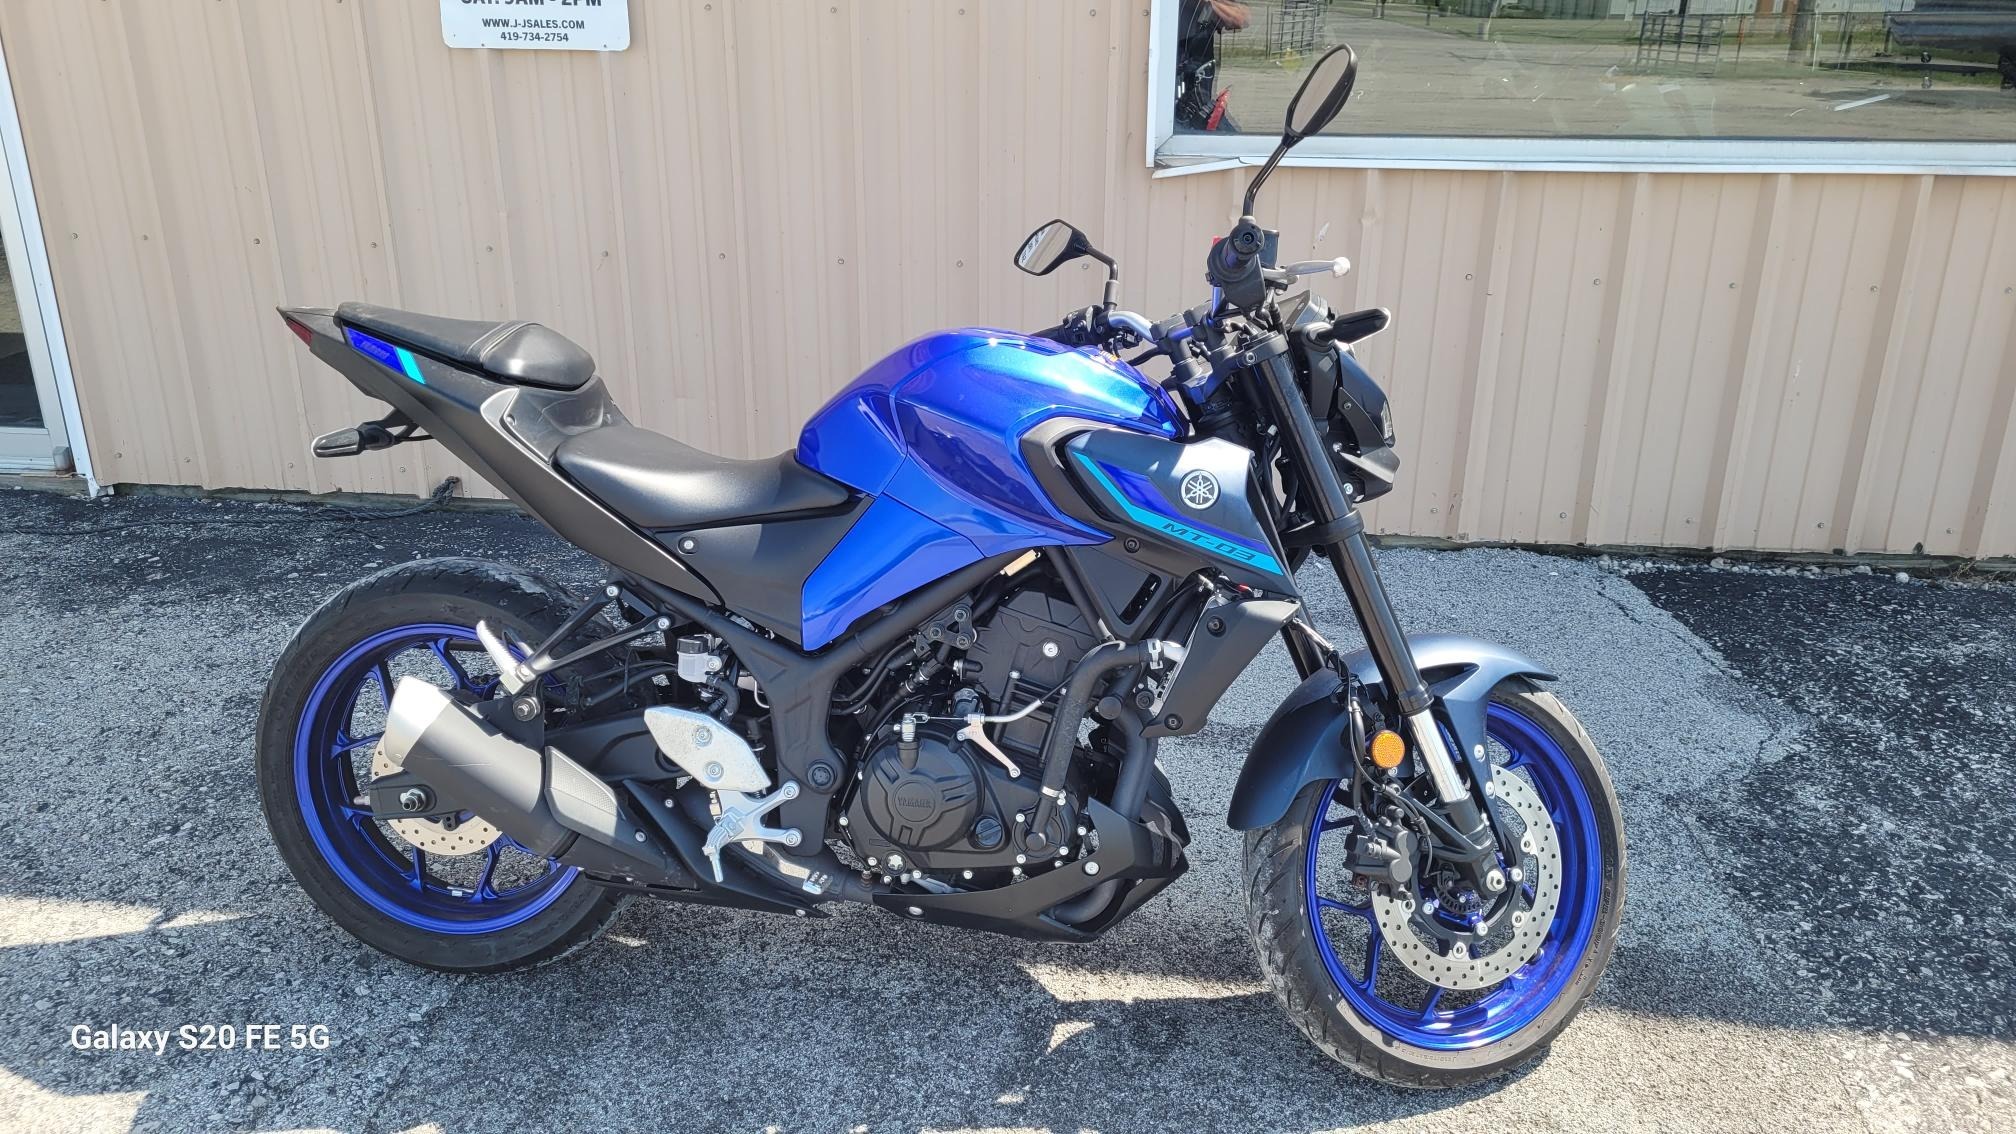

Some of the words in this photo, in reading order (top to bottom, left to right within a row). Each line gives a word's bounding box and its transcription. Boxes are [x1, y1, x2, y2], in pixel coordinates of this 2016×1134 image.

[482, 18, 585, 29] WWW.J-JSALES.COM
[500, 32, 569, 42] 419-734-2754
[1162, 522, 1257, 561] MT-03
[897, 796, 932, 809] YAMAHA
